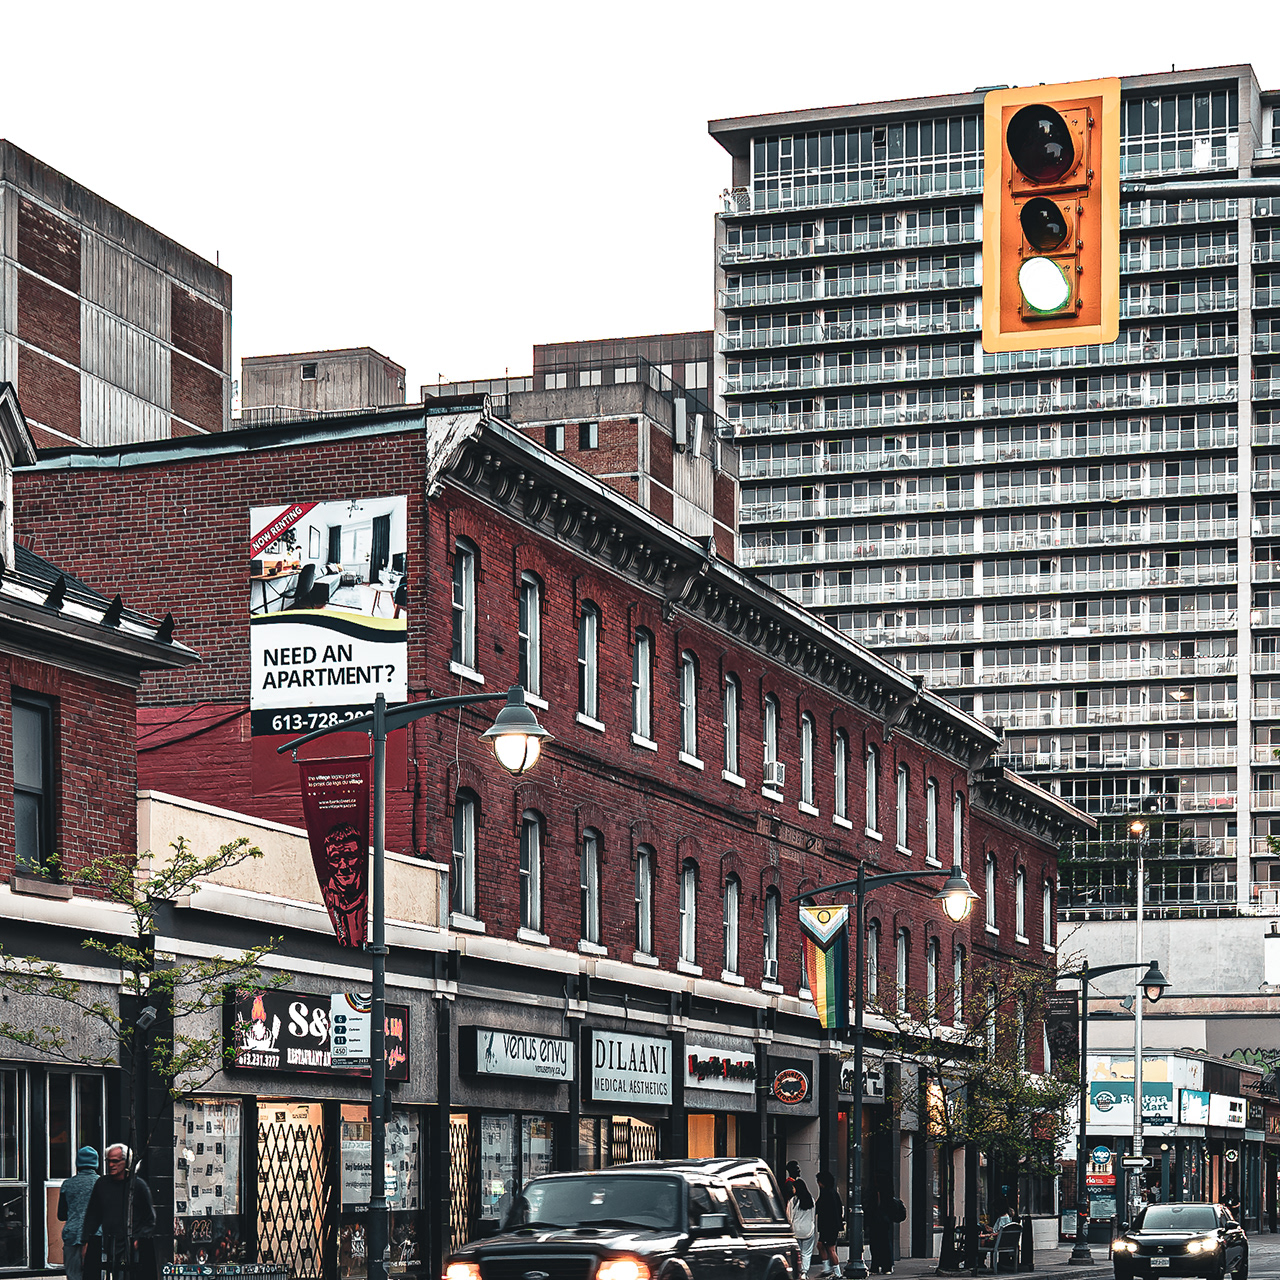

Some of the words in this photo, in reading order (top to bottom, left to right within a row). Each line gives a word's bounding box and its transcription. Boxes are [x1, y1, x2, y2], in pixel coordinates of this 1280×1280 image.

[252, 531, 272, 551] NOW
[270, 506, 303, 536] RENTING
[263, 646, 317, 667] NEED
[322, 644, 353, 663] AN
[262, 664, 395, 690] APARTMENT?
[288, 1002, 331, 1045] S&
[595, 1039, 667, 1075] DILAANI
[594, 1077, 627, 1093] MEDICAL
[629, 1080, 668, 1096] AESTHETICS
[1120, 1094, 1167, 1104] Etetera
[1142, 1102, 1168, 1111] Mart
